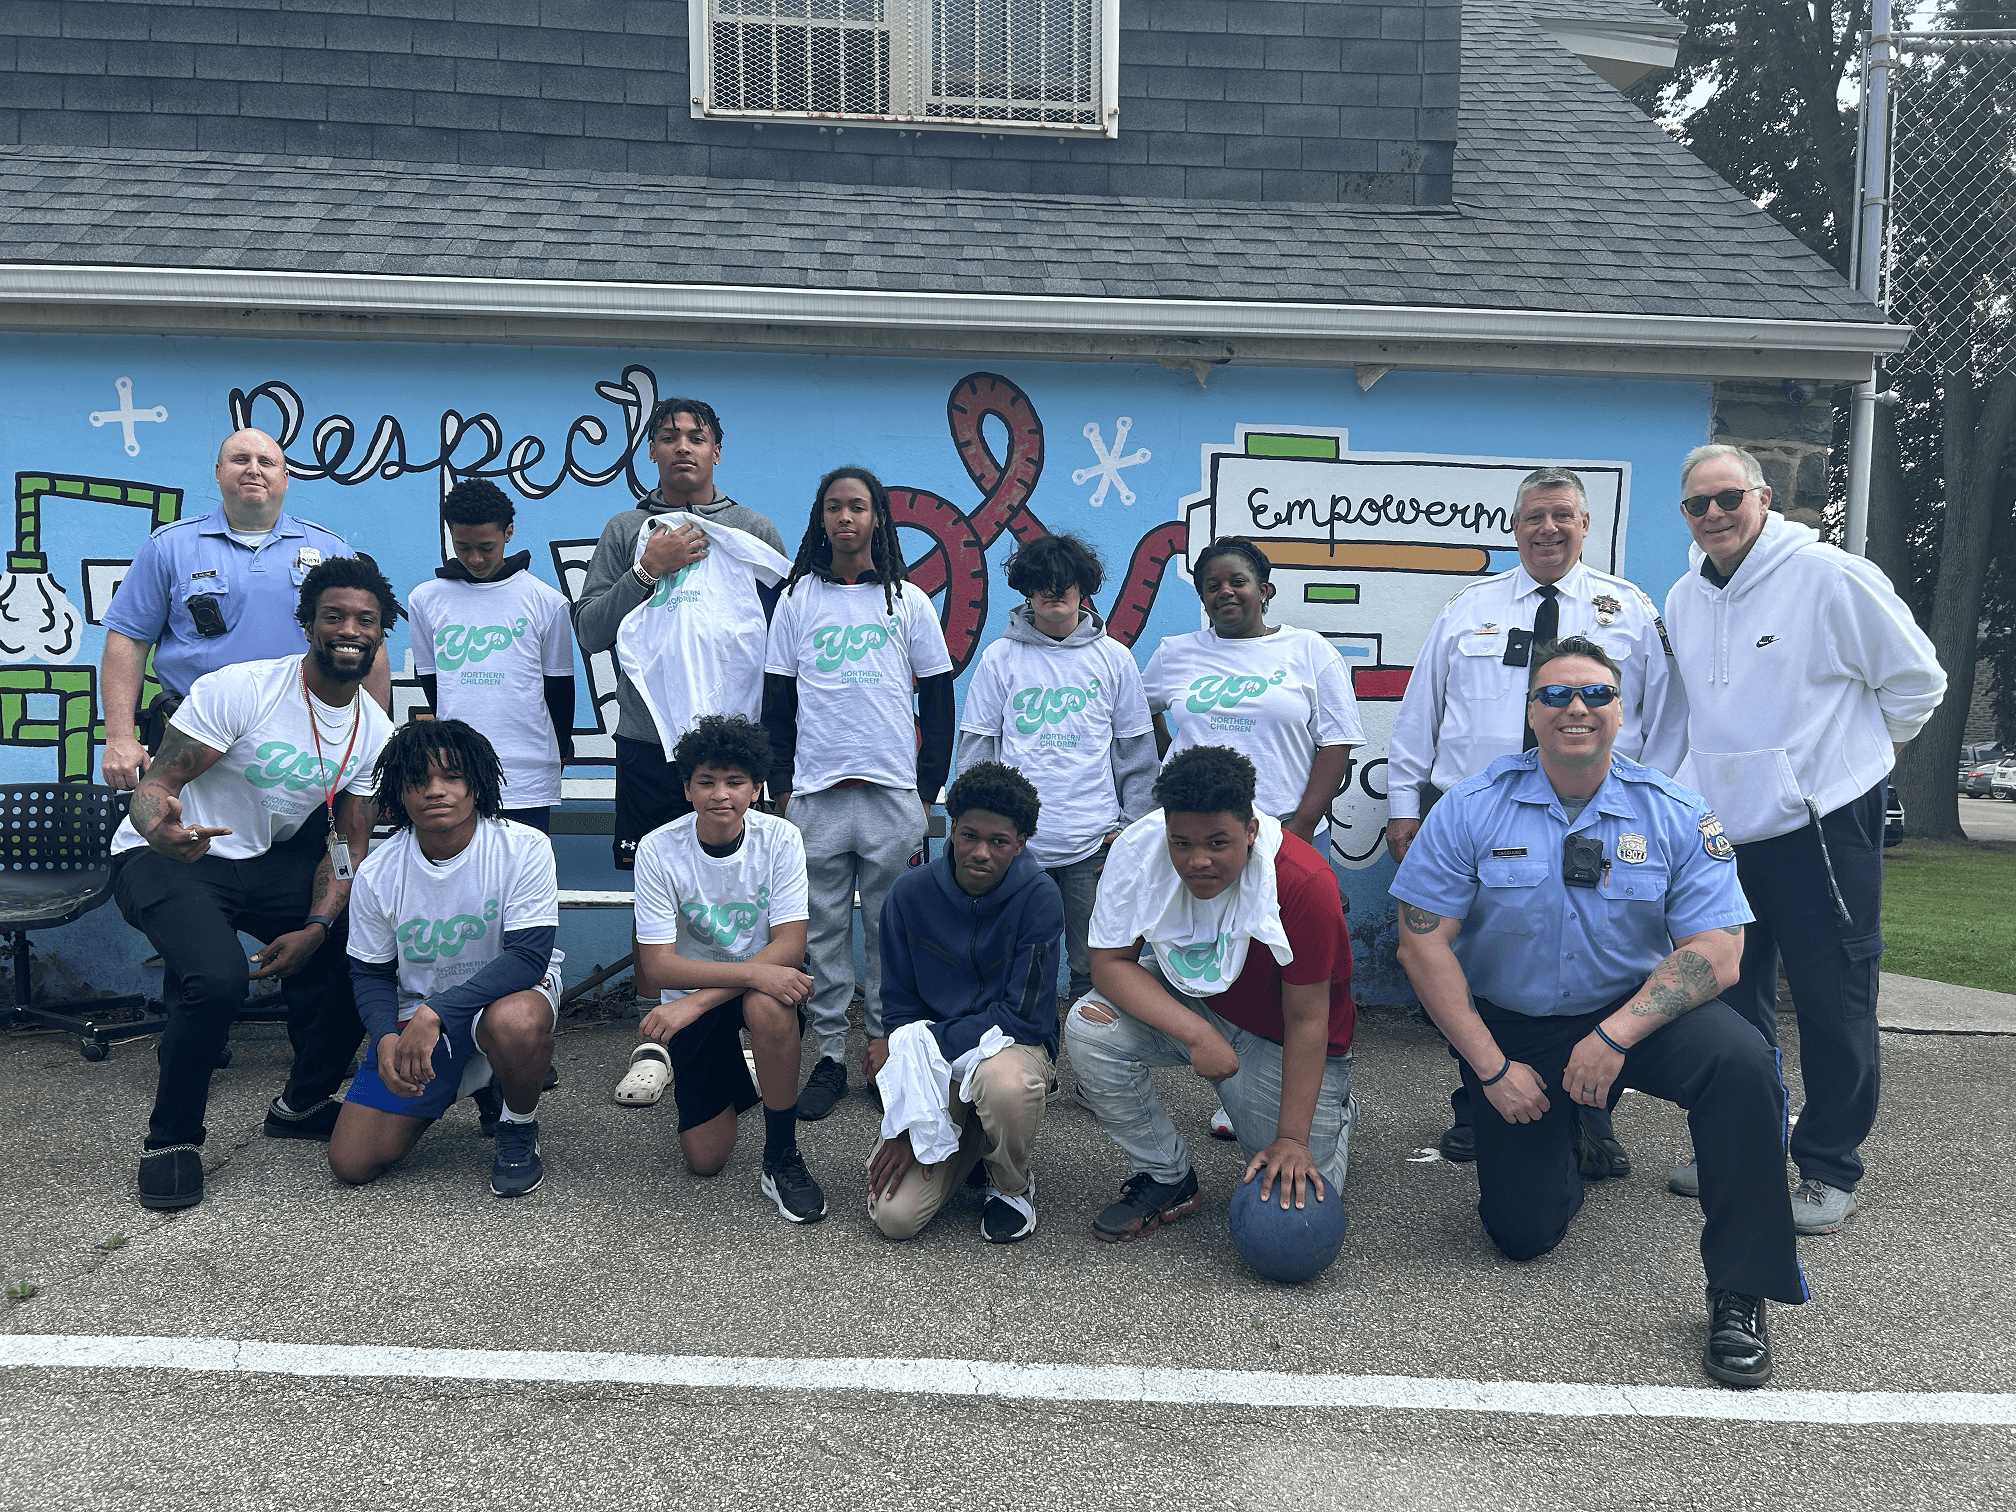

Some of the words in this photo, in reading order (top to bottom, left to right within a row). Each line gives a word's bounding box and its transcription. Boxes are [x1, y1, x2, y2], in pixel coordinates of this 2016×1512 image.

[229, 363, 659, 566] Respect
[1248, 487, 1514, 558] Empowerm
[460, 671, 505, 679] NORTHERN
[841, 670, 883, 679] NORTHERN
[460, 678, 501, 686] CHILDREN
[840, 677, 880, 685] CHILDREN
[1210, 715, 1256, 726] NORTHERN
[1210, 722, 1252, 733] CHILDREN
[1040, 733, 1080, 742] NORTHERN
[1039, 740, 1077, 748] CHILDREN
[261, 800, 300, 815] CHILDREN
[1621, 849, 1644, 860] 1907
[436, 960, 489, 974] NORTHERN
